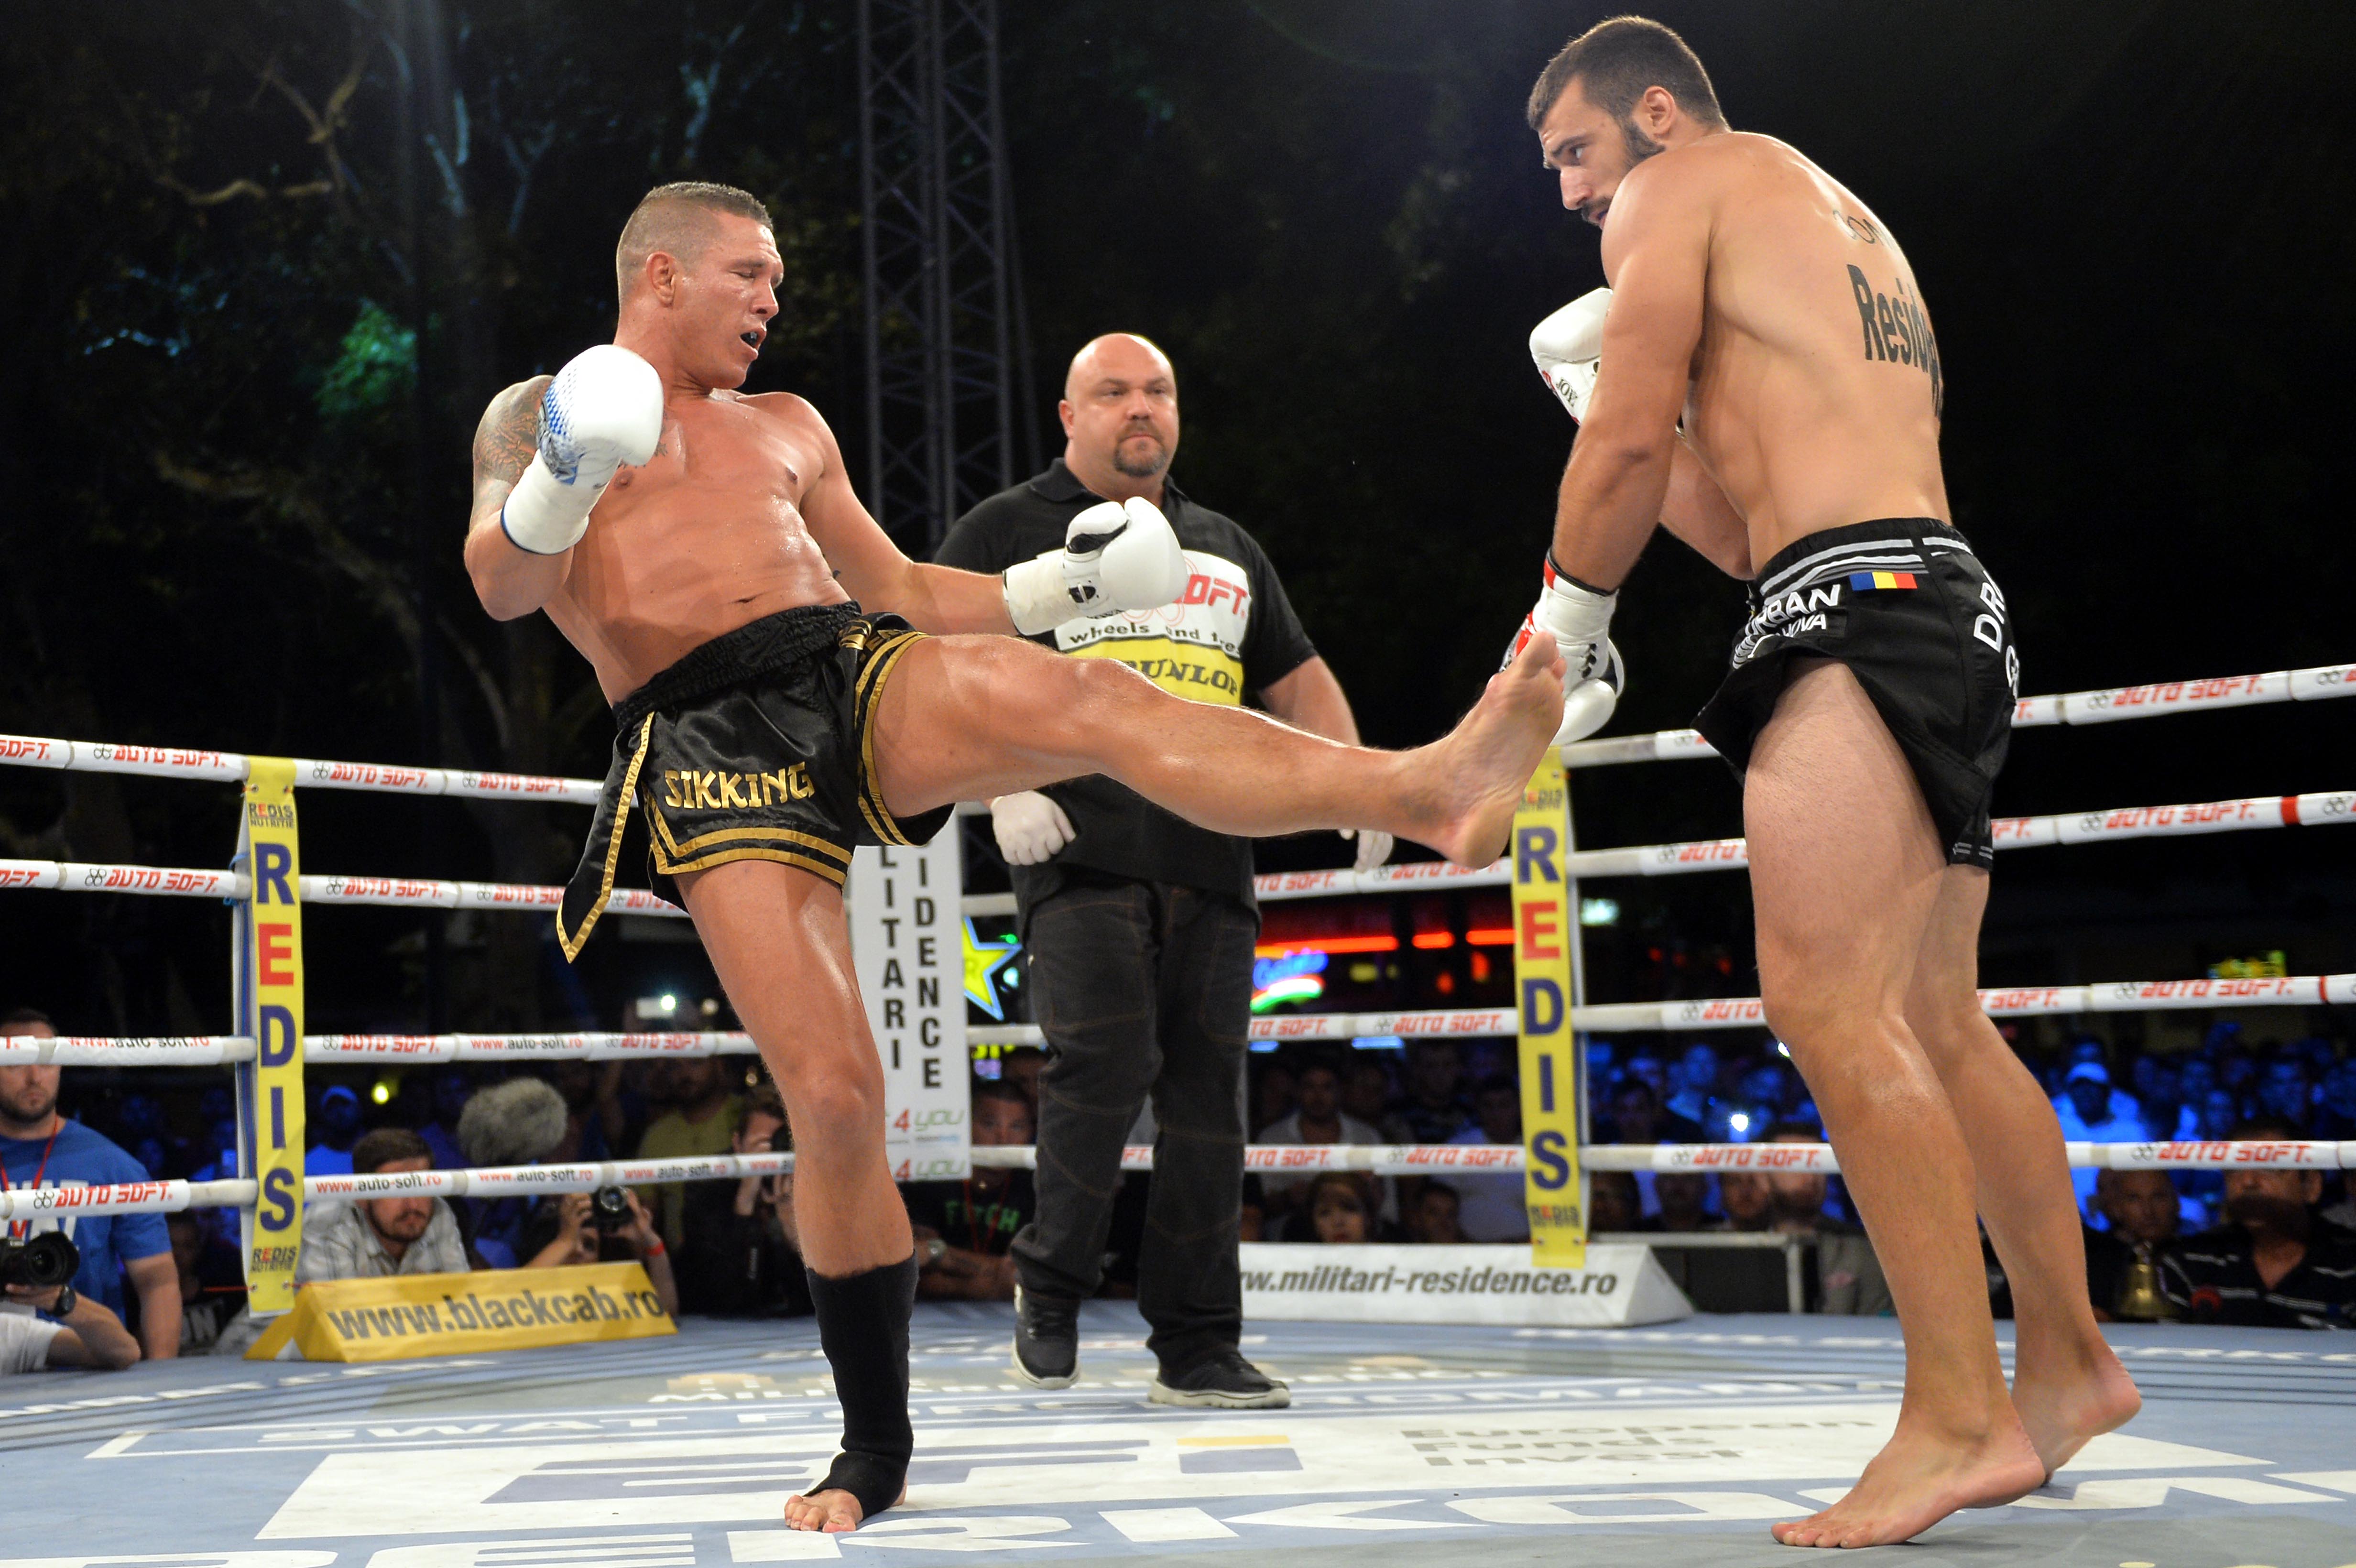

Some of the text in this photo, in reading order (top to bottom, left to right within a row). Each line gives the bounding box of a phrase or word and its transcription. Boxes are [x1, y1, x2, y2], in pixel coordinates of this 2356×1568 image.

[1069, 622, 1150, 643] wheels
[2113, 682, 2184, 707] AUTO
[113, 745, 166, 763] AUTO
[330, 763, 377, 783] AUTO
[665, 762, 815, 809] SIKKING
[249, 803, 293, 819] REDIS
[2105, 806, 2175, 829] AUTO
[104, 869, 161, 889] AUTO
[343, 878, 391, 896] AUTO
[914, 844, 941, 1089] IDENCE
[2140, 980, 2212, 998] AUTO
[1517, 827, 1570, 1190] REDIS
[1394, 1017, 1445, 1033] AUTO
[255, 843, 296, 1232] REDIS
[341, 1034, 387, 1051] AUTO
[2158, 1142, 2232, 1160] AUTO
[316, 1175, 442, 1194] www.auto-soft.ro
[479, 1169, 593, 1183] www.auto-soft.ro
[55, 1186, 111, 1208] AUTO
[252, 1247, 297, 1263] REDIS
[327, 1286, 665, 1340] www.blackcab.ro
[257, 1416, 687, 1443] SWAT
[1412, 1436, 1716, 1452] Funds
[1424, 1449, 1744, 1466] Invest
